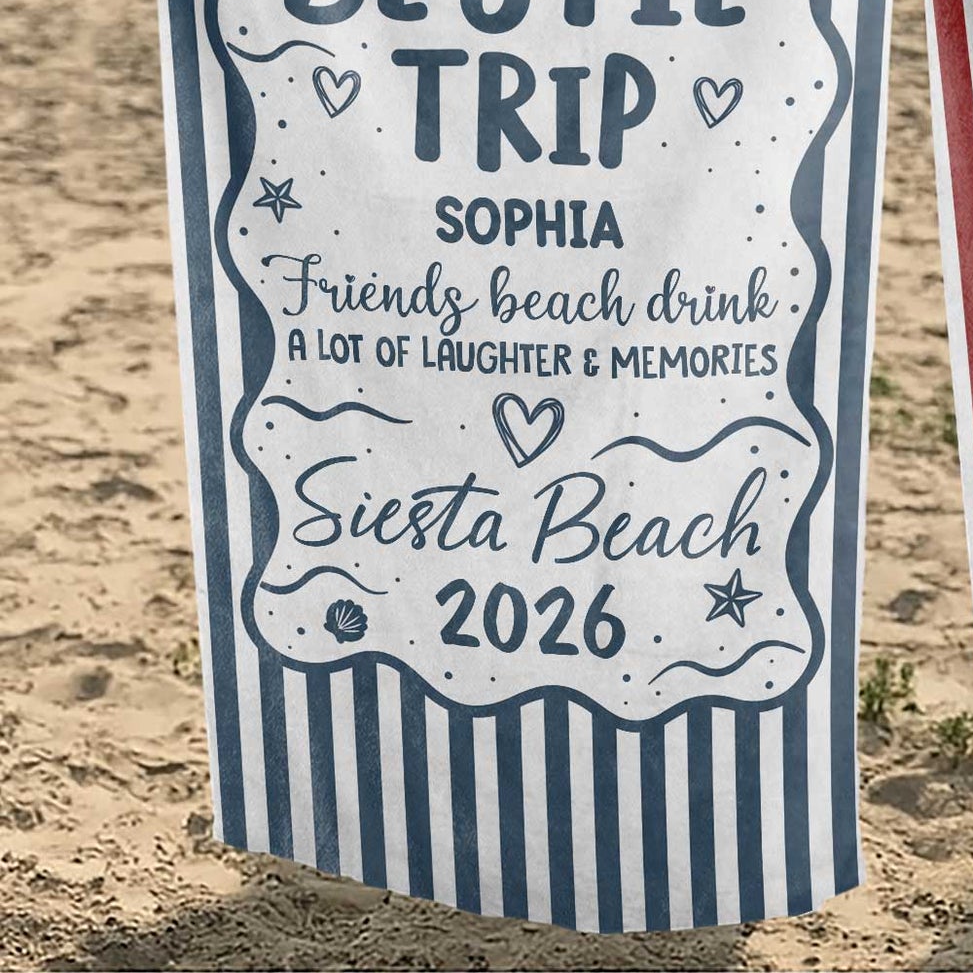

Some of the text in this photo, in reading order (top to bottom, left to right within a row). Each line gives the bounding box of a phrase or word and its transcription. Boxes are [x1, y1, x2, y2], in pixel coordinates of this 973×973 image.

[391, 48, 656, 173] TRIP
[435, 196, 624, 249] SOPHIA
[262, 254, 778, 335] Friends beach drink
[288, 328, 307, 361] A
[318, 331, 362, 365] LOT
[377, 336, 410, 368] OF
[423, 339, 572, 377] LAUGHTER
[611, 344, 778, 380] MEMORIES
[292, 455, 768, 564] Siesta Beach
[435, 578, 627, 659] 2026
